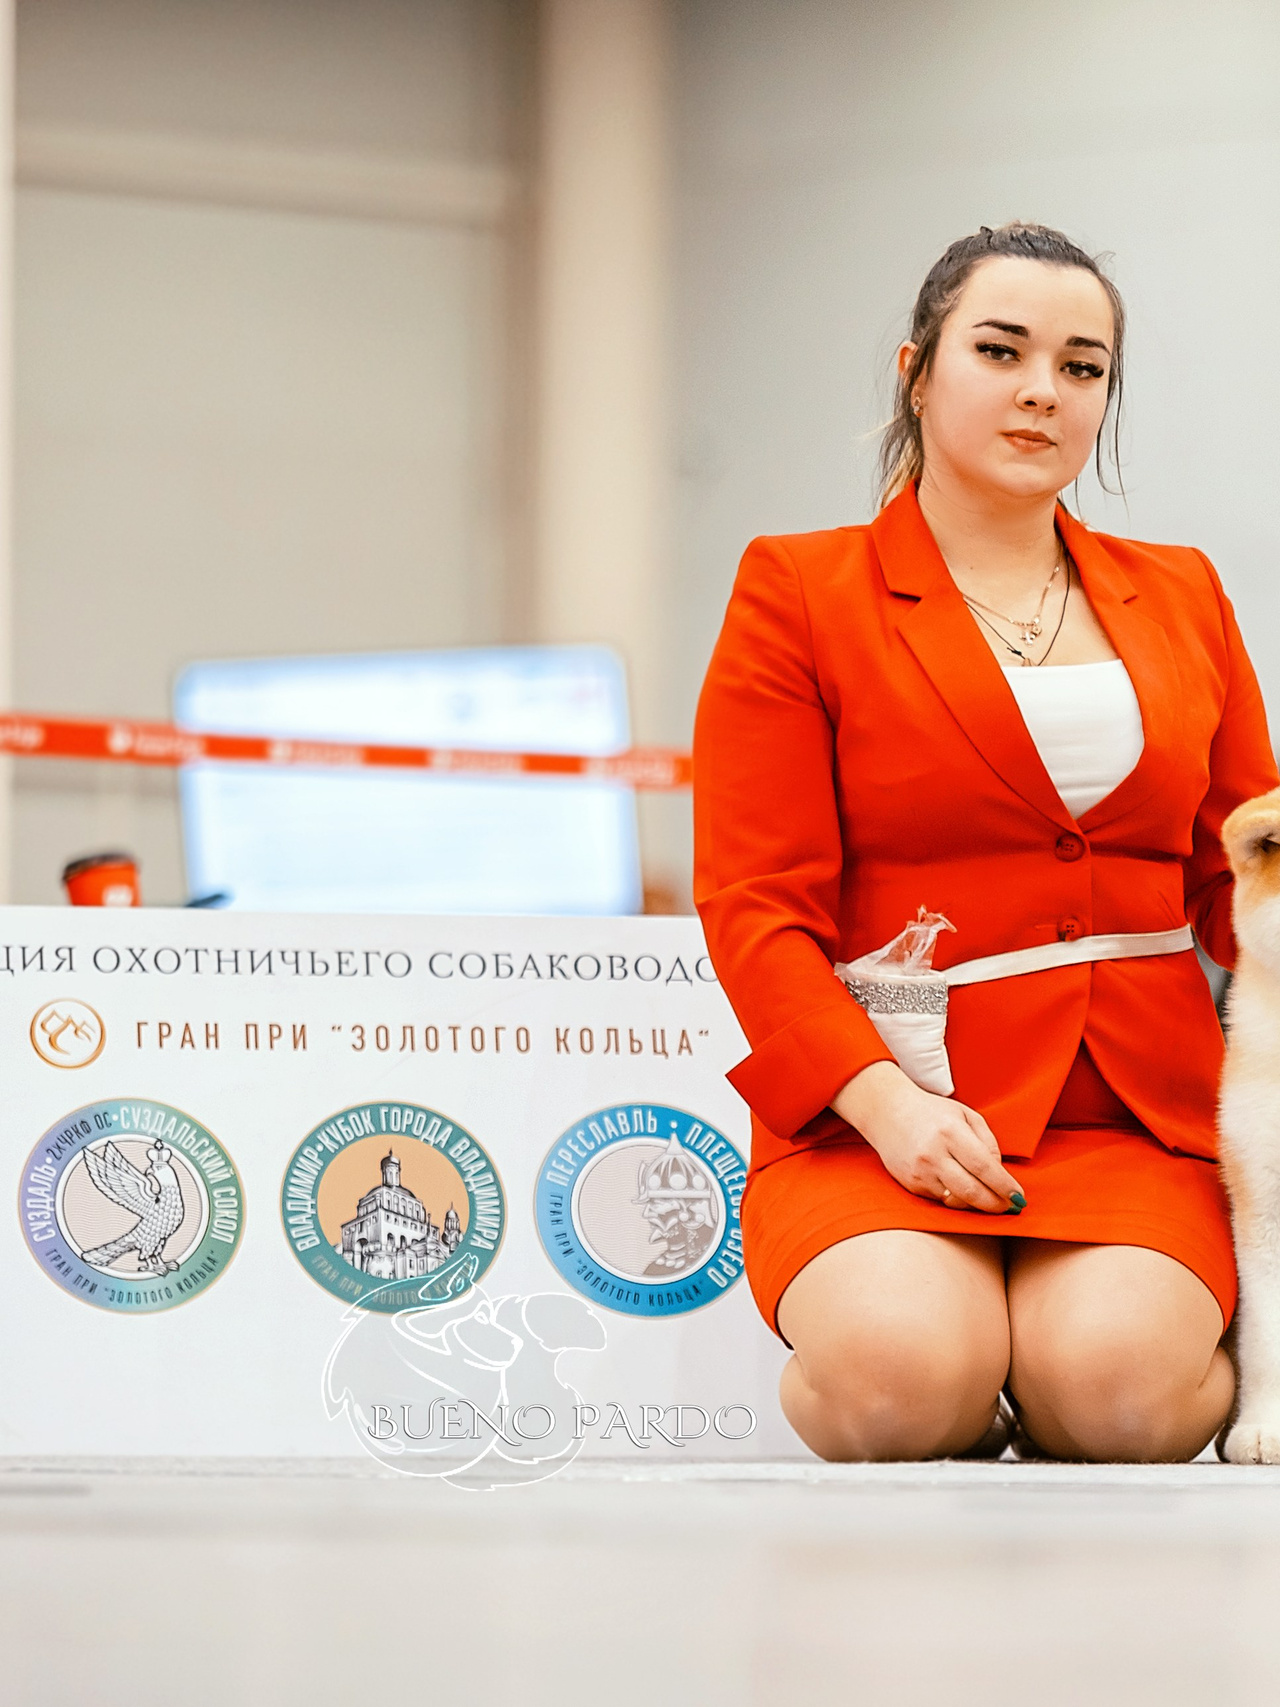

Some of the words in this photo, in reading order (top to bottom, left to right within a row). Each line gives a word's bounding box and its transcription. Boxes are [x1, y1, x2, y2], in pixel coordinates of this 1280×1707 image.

[93, 946, 413, 979] ОХОТНИЧЬЕГО
[136, 1021, 219, 1050] ГРАН
[244, 1023, 308, 1051] ПРИ
[331, 1024, 531, 1055] "ЗОЛОТОГО
[555, 1026, 709, 1060] КОЛЬЦА"
[546, 1109, 657, 1187] ПЕРЕСЛАВЛЬ
[120, 1106, 236, 1184] СУЗДАЛЬСКИЙ
[210, 1186, 238, 1244] СОКОЛ
[286, 1145, 324, 1251] ВЛАДИМИР
[317, 1109, 376, 1153] КУБОК
[379, 1106, 453, 1148] ГОРОДА
[448, 1138, 500, 1251] ВЛАДИМИРА
[550, 1193, 564, 1225] ГРАН
[554, 1231, 574, 1258] ПРИ
[45, 1248, 73, 1278] ГРАН
[74, 1274, 98, 1295] ПРИ
